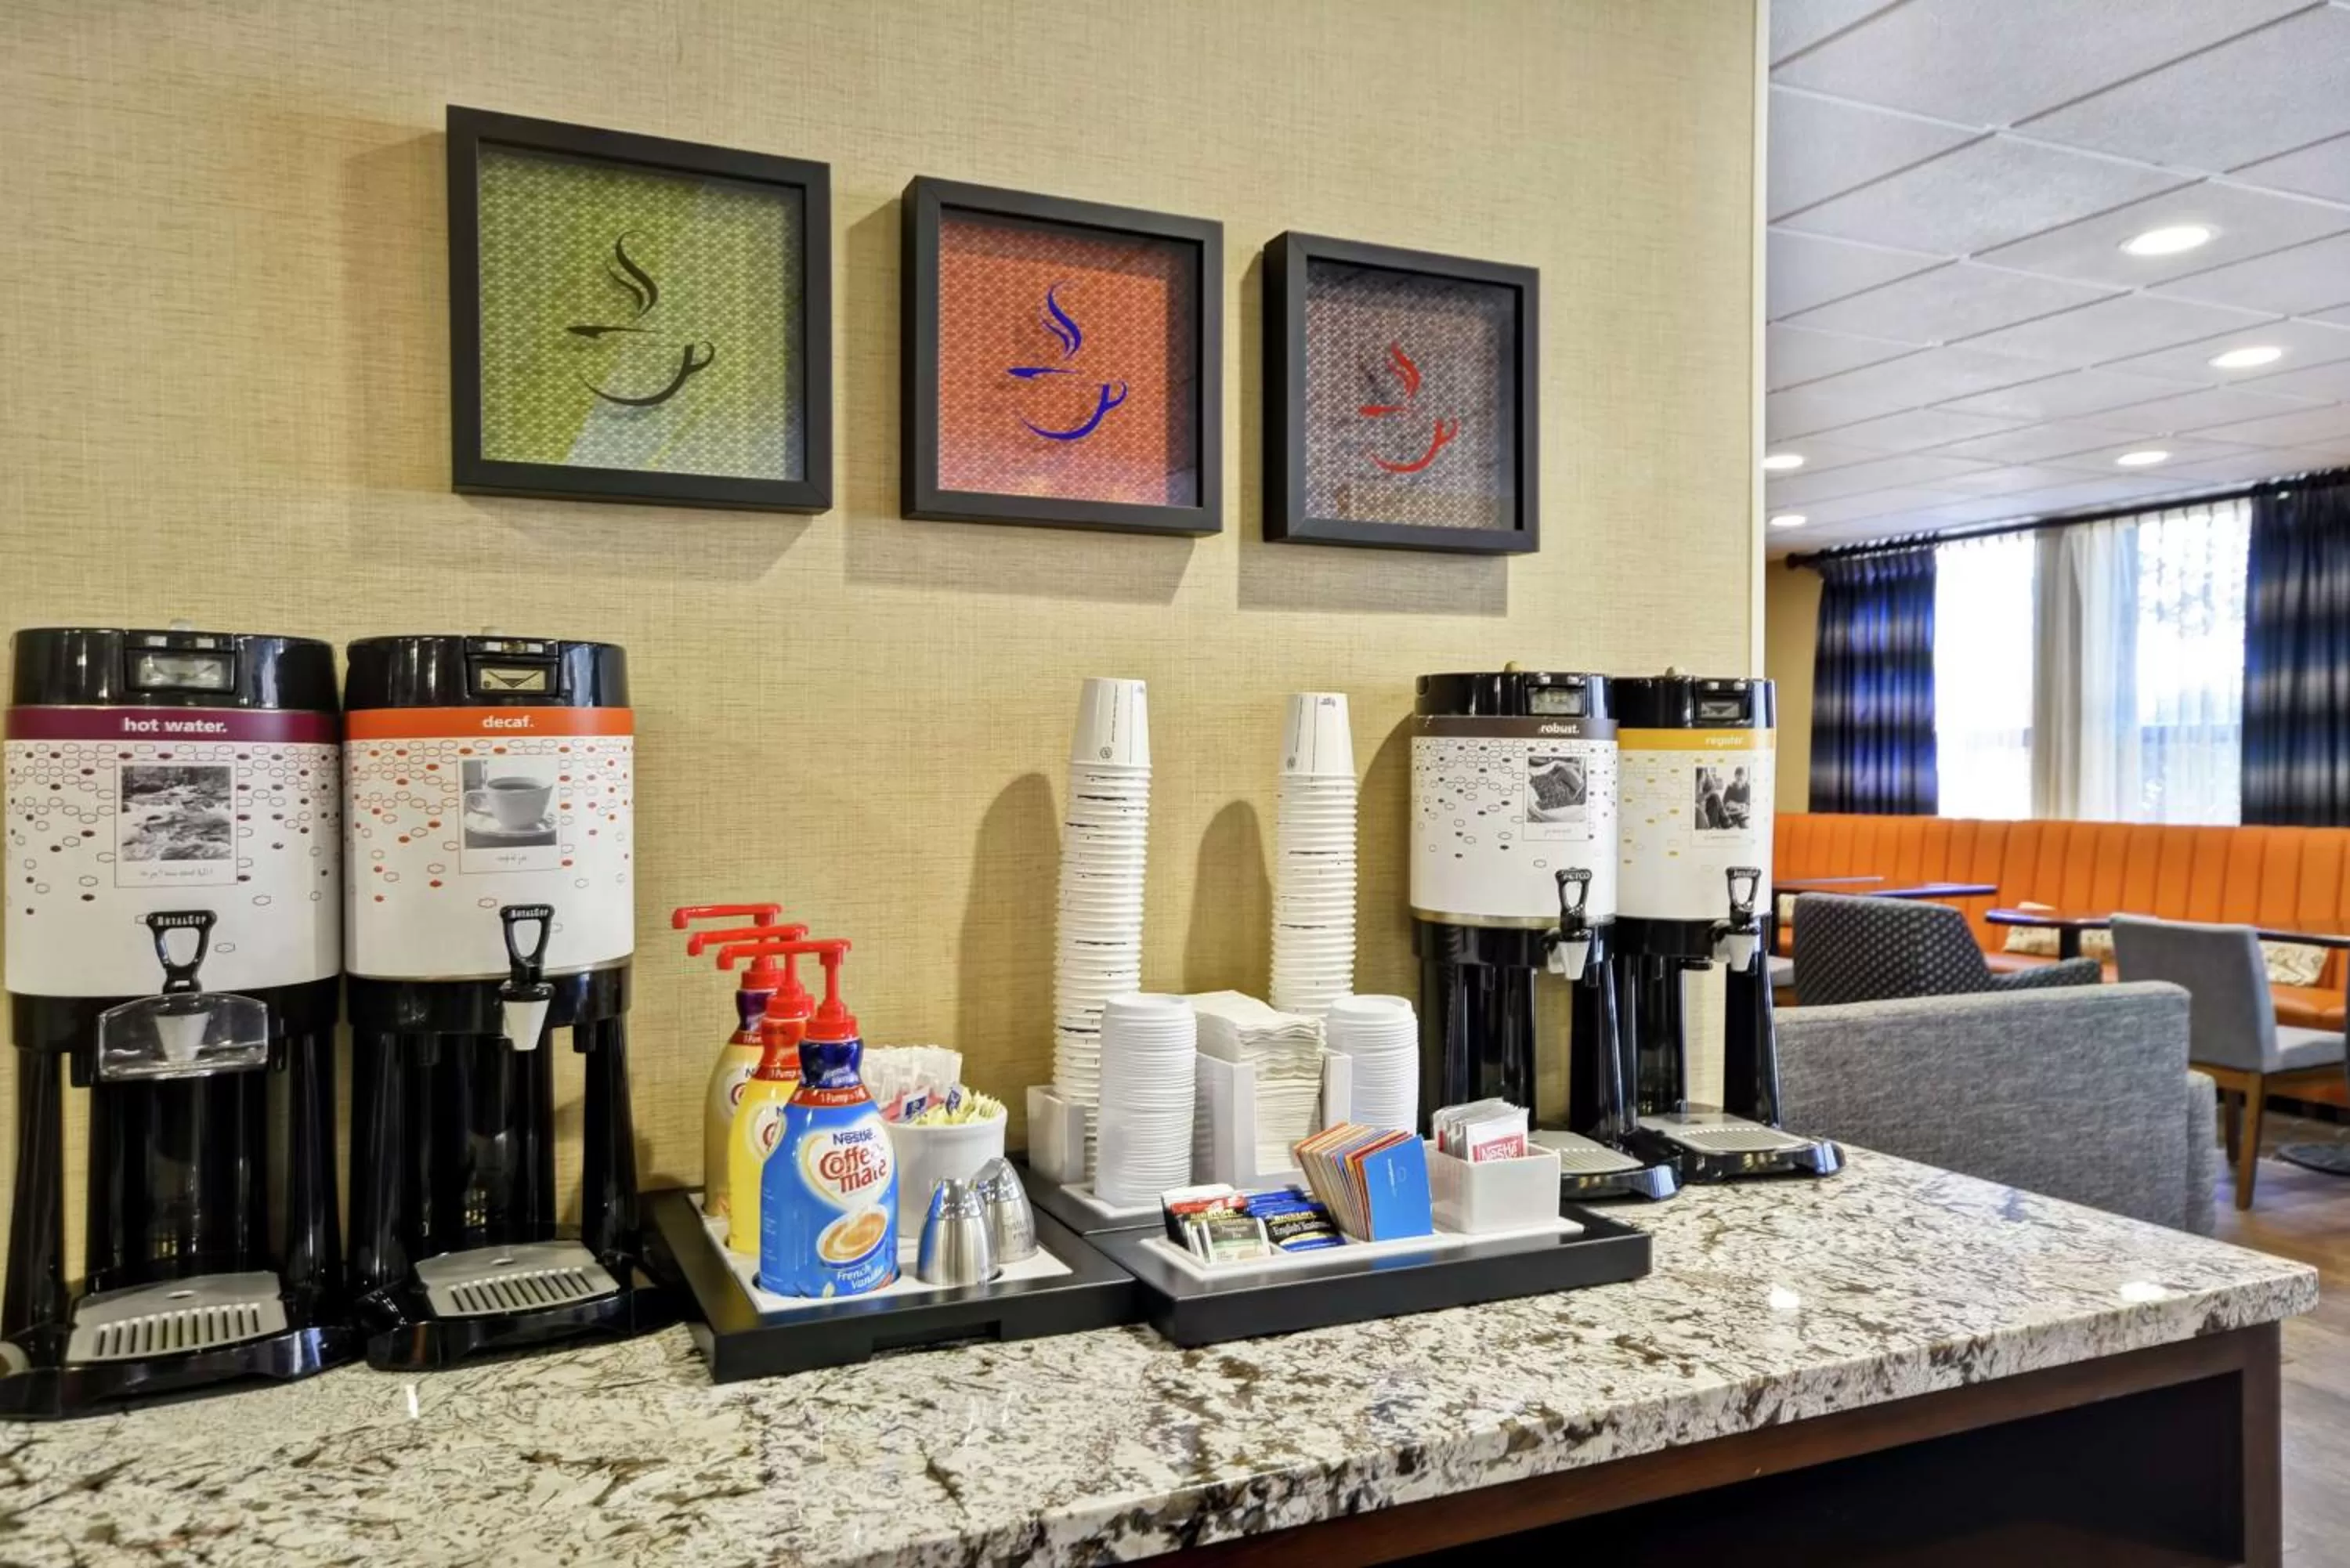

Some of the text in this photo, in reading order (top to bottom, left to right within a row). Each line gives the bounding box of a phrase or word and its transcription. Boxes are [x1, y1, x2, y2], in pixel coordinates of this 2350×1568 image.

[124, 717, 228, 733] hot water.
[483, 714, 535, 728] decaf.
[1540, 722, 1580, 734] robust.
[819, 1145, 884, 1180] Coffe
